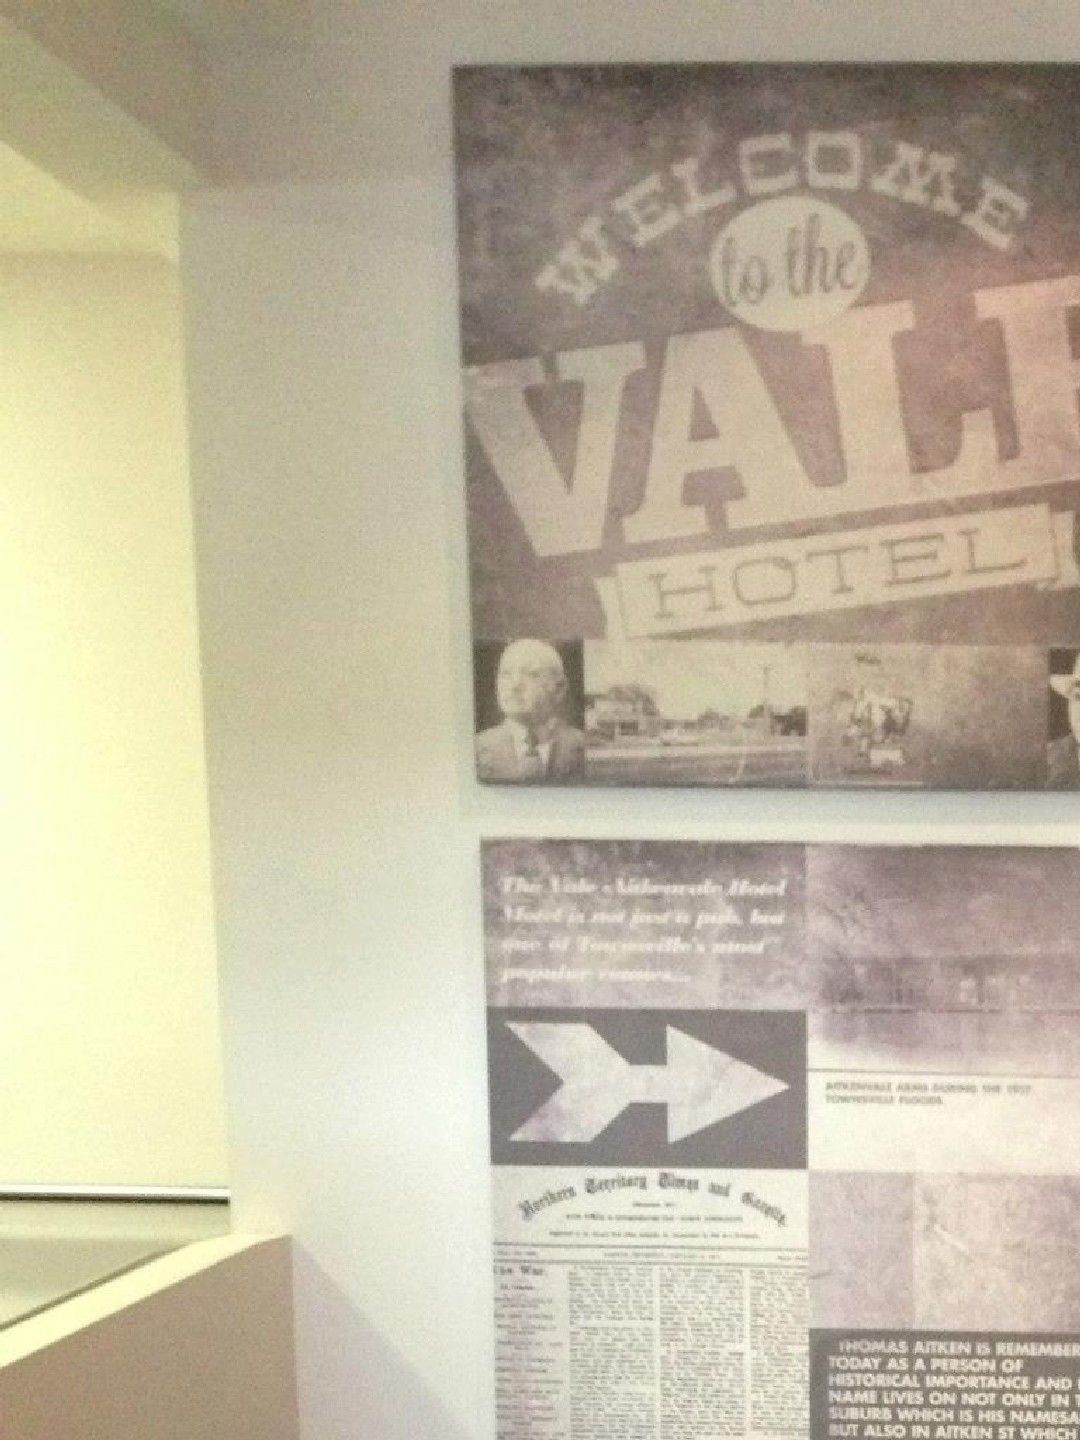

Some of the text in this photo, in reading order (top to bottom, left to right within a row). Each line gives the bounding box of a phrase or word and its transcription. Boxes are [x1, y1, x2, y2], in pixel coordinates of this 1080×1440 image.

[534, 131, 1031, 304] WELCOME
[716, 212, 858, 309] to the
[649, 526, 1029, 620] HOTEL
[839, 1340, 908, 1354] THOMAS
[913, 1340, 972, 1355] AITKEN
[976, 1342, 990, 1356] IS
[828, 1355, 1024, 1373] TODAY AS A PERSON OF
[828, 1373, 920, 1387] HISTORICAL
[925, 1375, 1029, 1389] IMPORTANCE
[1035, 1376, 1073, 1391] AND
[828, 1390, 878, 1404] NAME
[883, 1391, 924, 1405] LIVES
[929, 1391, 956, 1405] ON
[961, 1392, 996, 1406] NOT
[1002, 1393, 1046, 1407] ONLY
[1051, 1393, 1069, 1407] IN
[828, 1407, 892, 1421] SUBURB
[897, 1408, 954, 1422] WHICH
[959, 1409, 973, 1422] IS
[978, 1409, 1005, 1423] HIS
[828, 1423, 1078, 1440] BUT ALSO IN AITKEN ST WHICH
